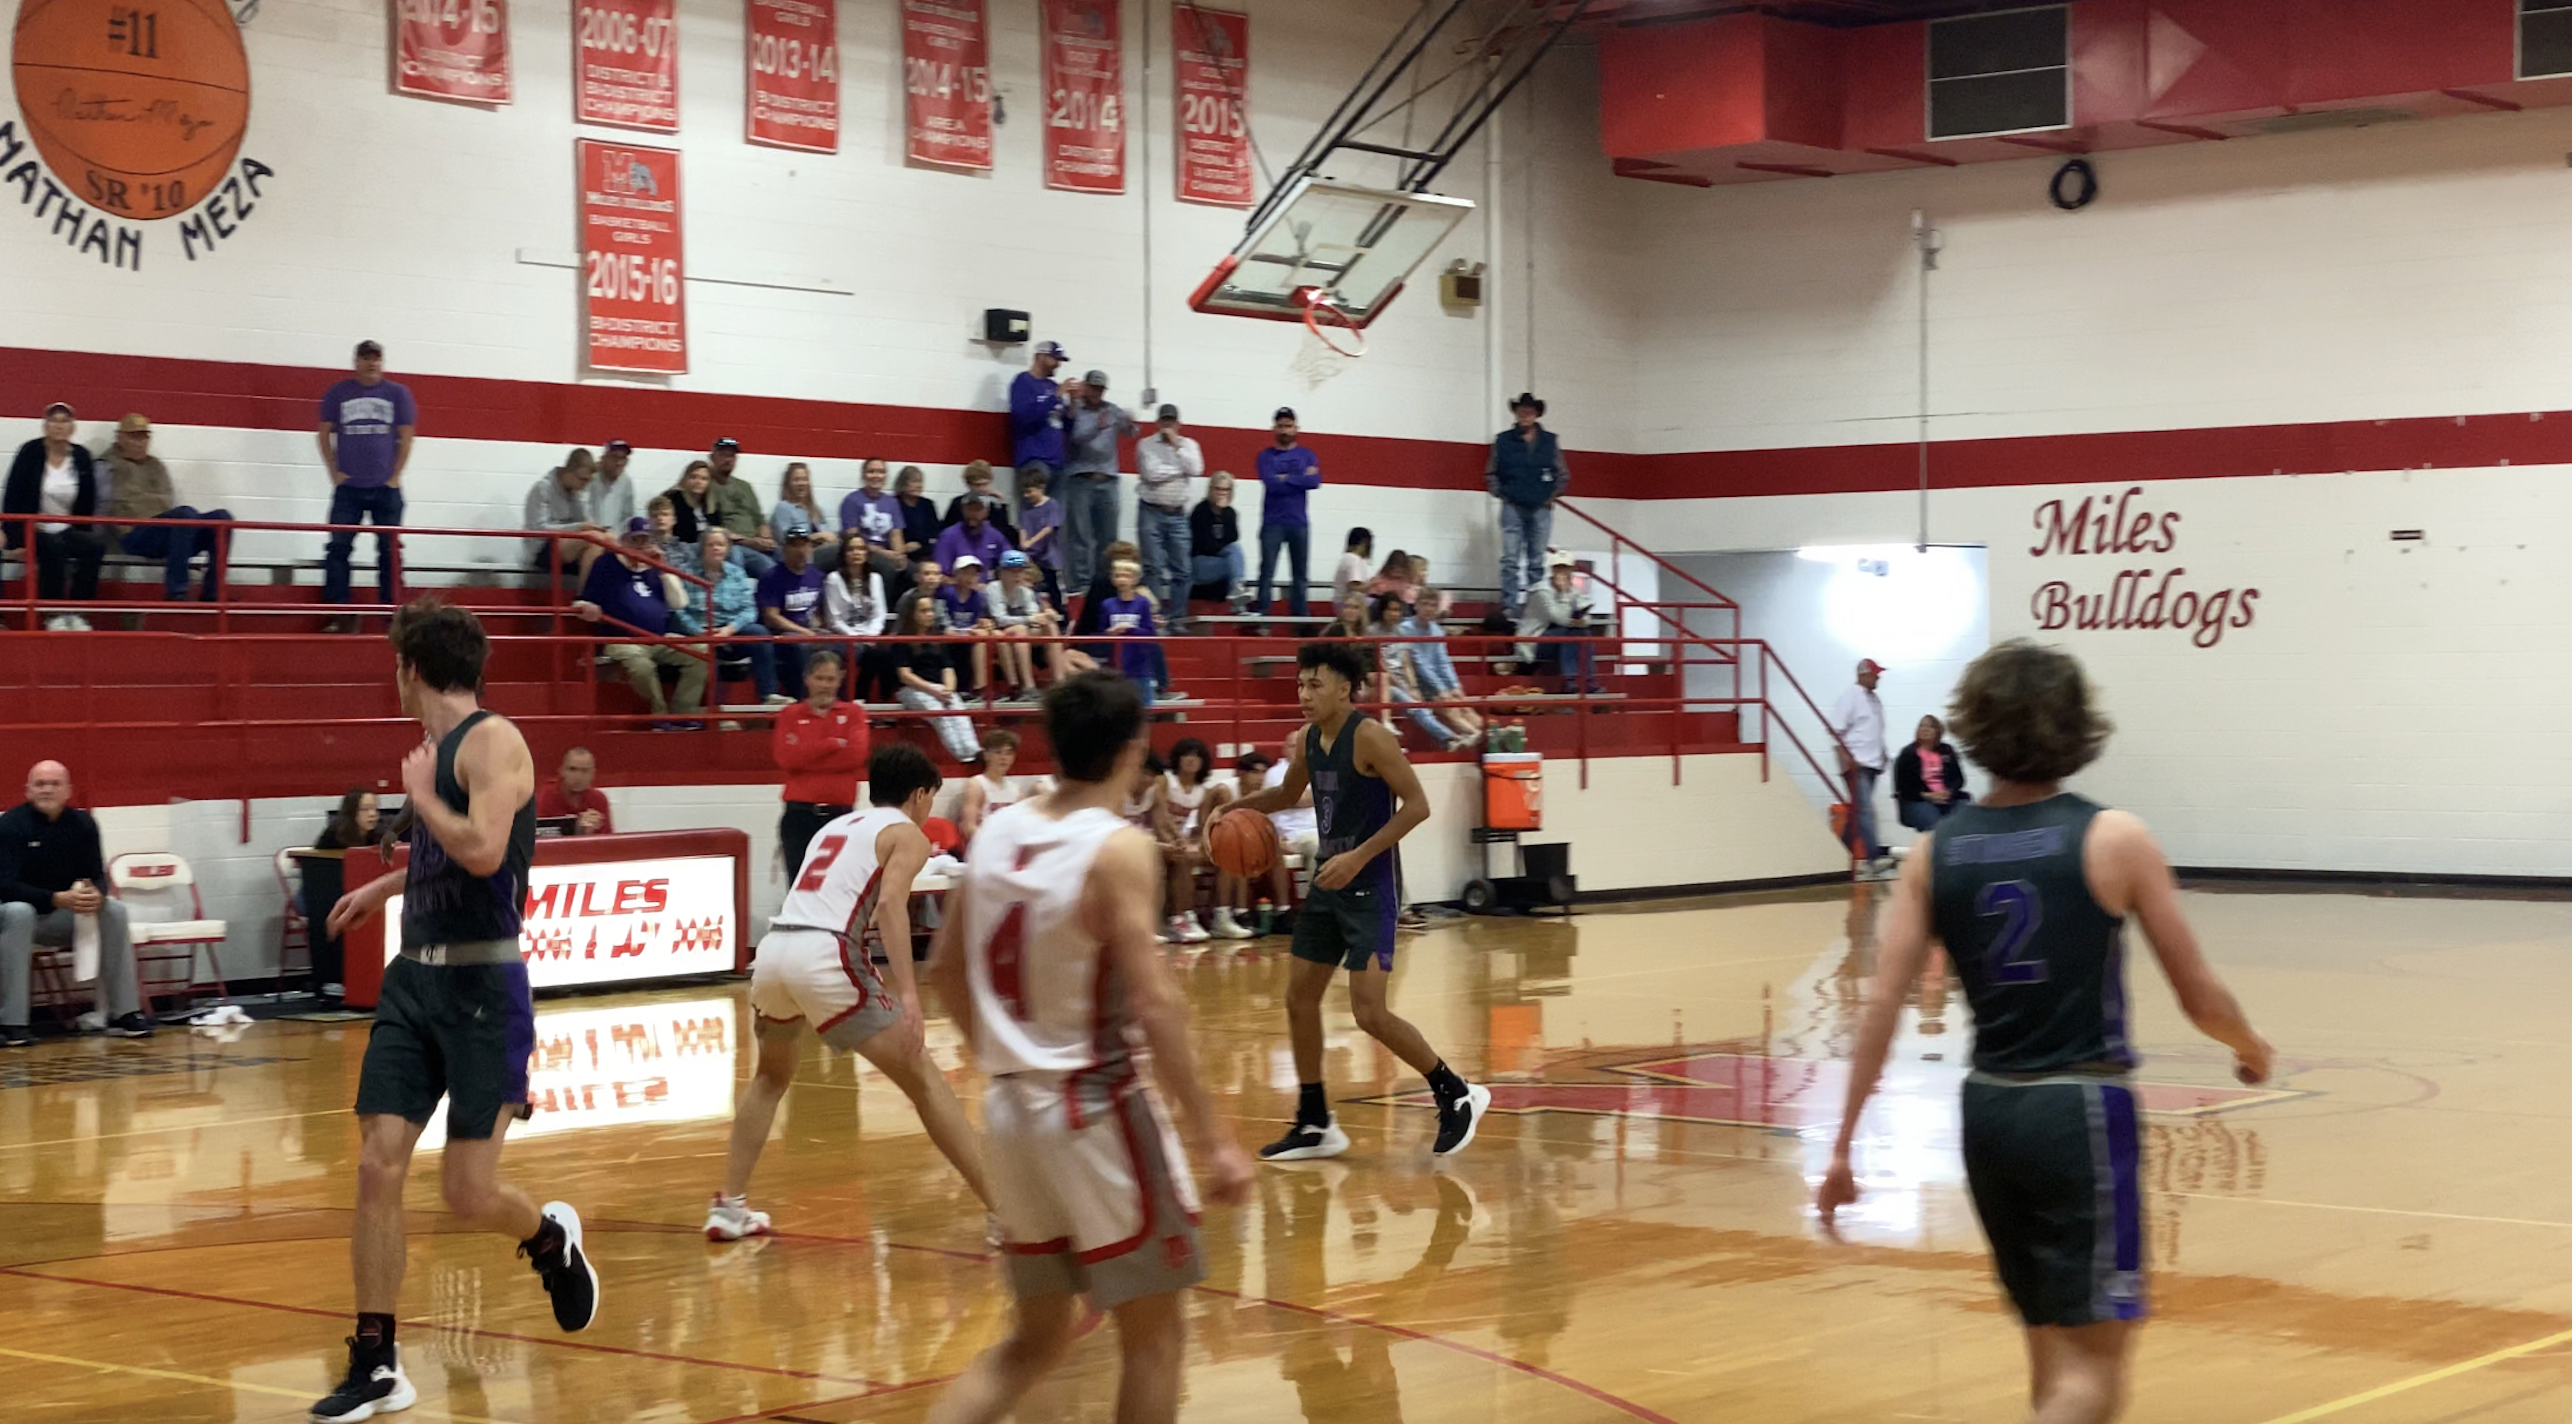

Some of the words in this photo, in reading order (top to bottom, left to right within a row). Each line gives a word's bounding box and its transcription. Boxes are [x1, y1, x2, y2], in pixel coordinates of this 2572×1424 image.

[580, 7, 672, 58] 2006-07
[587, 64, 657, 86] DISTRICT
[754, 33, 838, 83] 2013-14
[585, 98, 677, 121] CHAMPIONS
[754, 106, 838, 131] CHAMPIONS
[1050, 89, 1118, 132] 2014
[1181, 94, 1245, 137] 2015
[86, 170, 132, 210] SR
[180, 158, 274, 260] MEZA
[589, 214, 673, 233] BASKETBALL
[613, 231, 652, 244] GIRLS
[588, 251, 678, 305] 2015-16
[590, 333, 682, 352] CHAMPIONS
[2028, 486, 2182, 557] Miles
[2031, 567, 2261, 648] Bulldogs
[795, 834, 847, 891] 2
[523, 878, 670, 920] MILES
[1974, 879, 2048, 986] 2
